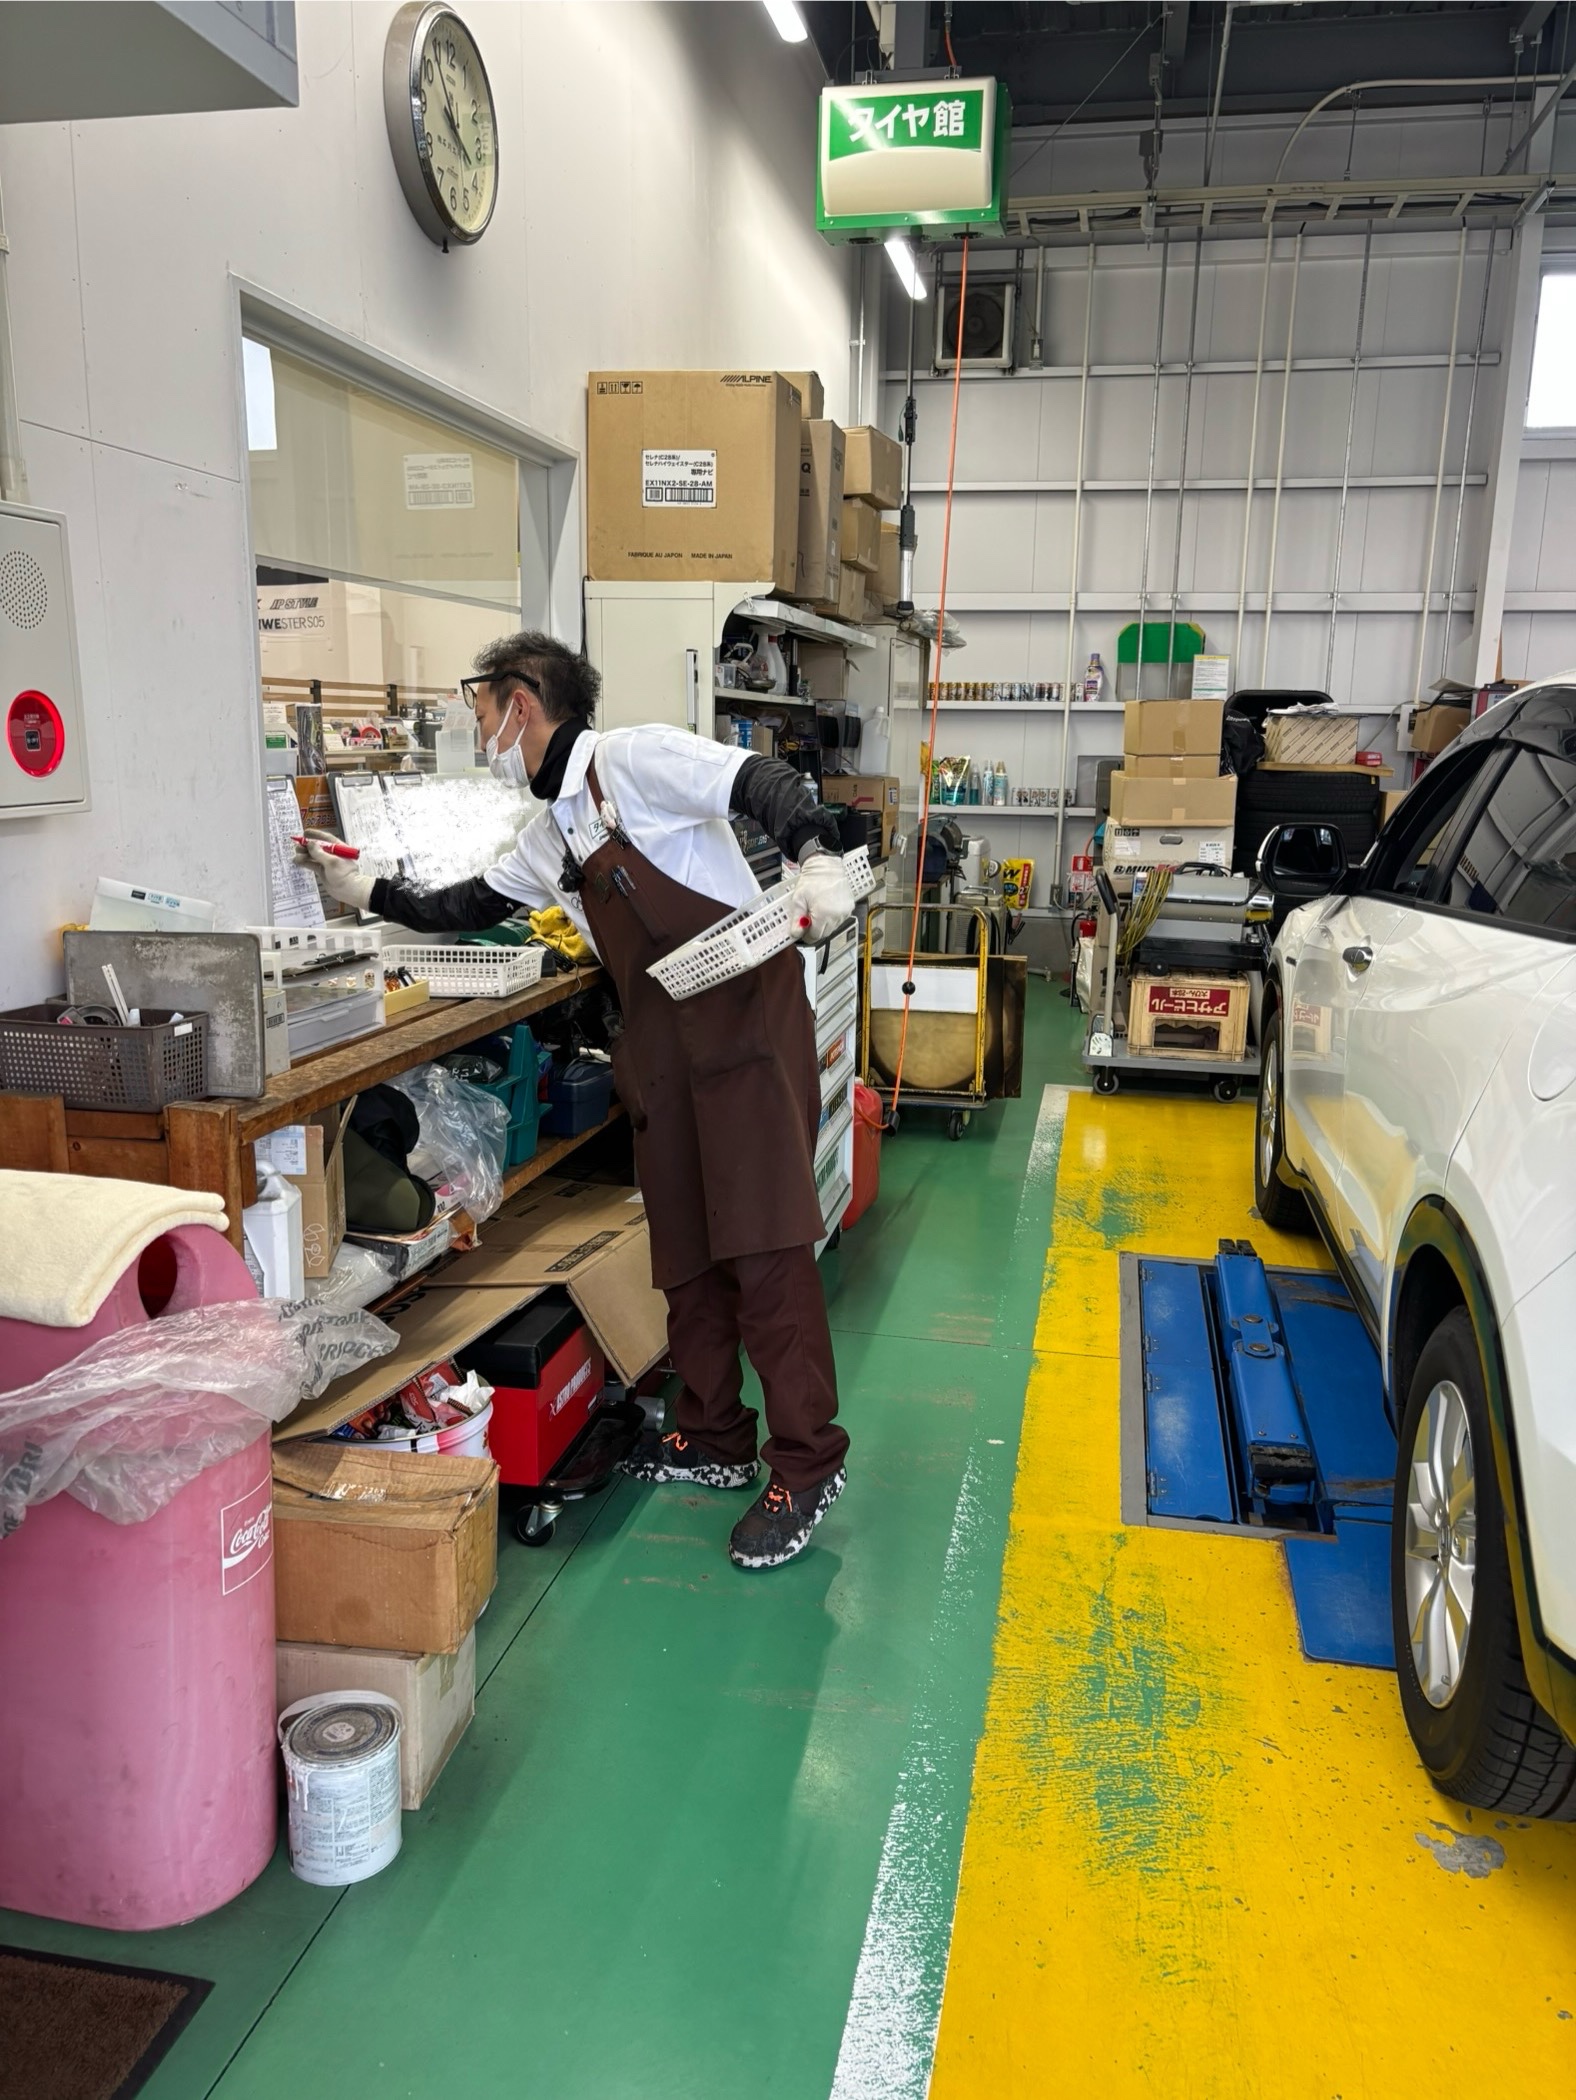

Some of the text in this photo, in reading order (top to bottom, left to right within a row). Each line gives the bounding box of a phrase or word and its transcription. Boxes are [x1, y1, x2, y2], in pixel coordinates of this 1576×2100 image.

[445, 38, 456, 70] 12
[423, 55, 434, 84] 10
[462, 64, 468, 90] 1
[471, 99, 478, 124] 2
[848, 100, 966, 142] タイヤ館
[475, 137, 482, 161] 3
[437, 166, 444, 192] 7
[472, 171, 478, 194] 4
[450, 187, 457, 211] 6
[463, 188, 470, 211] 5
[735, 374, 773, 384] ALPINE
[1151, 998, 1227, 1015] アサヒビール
